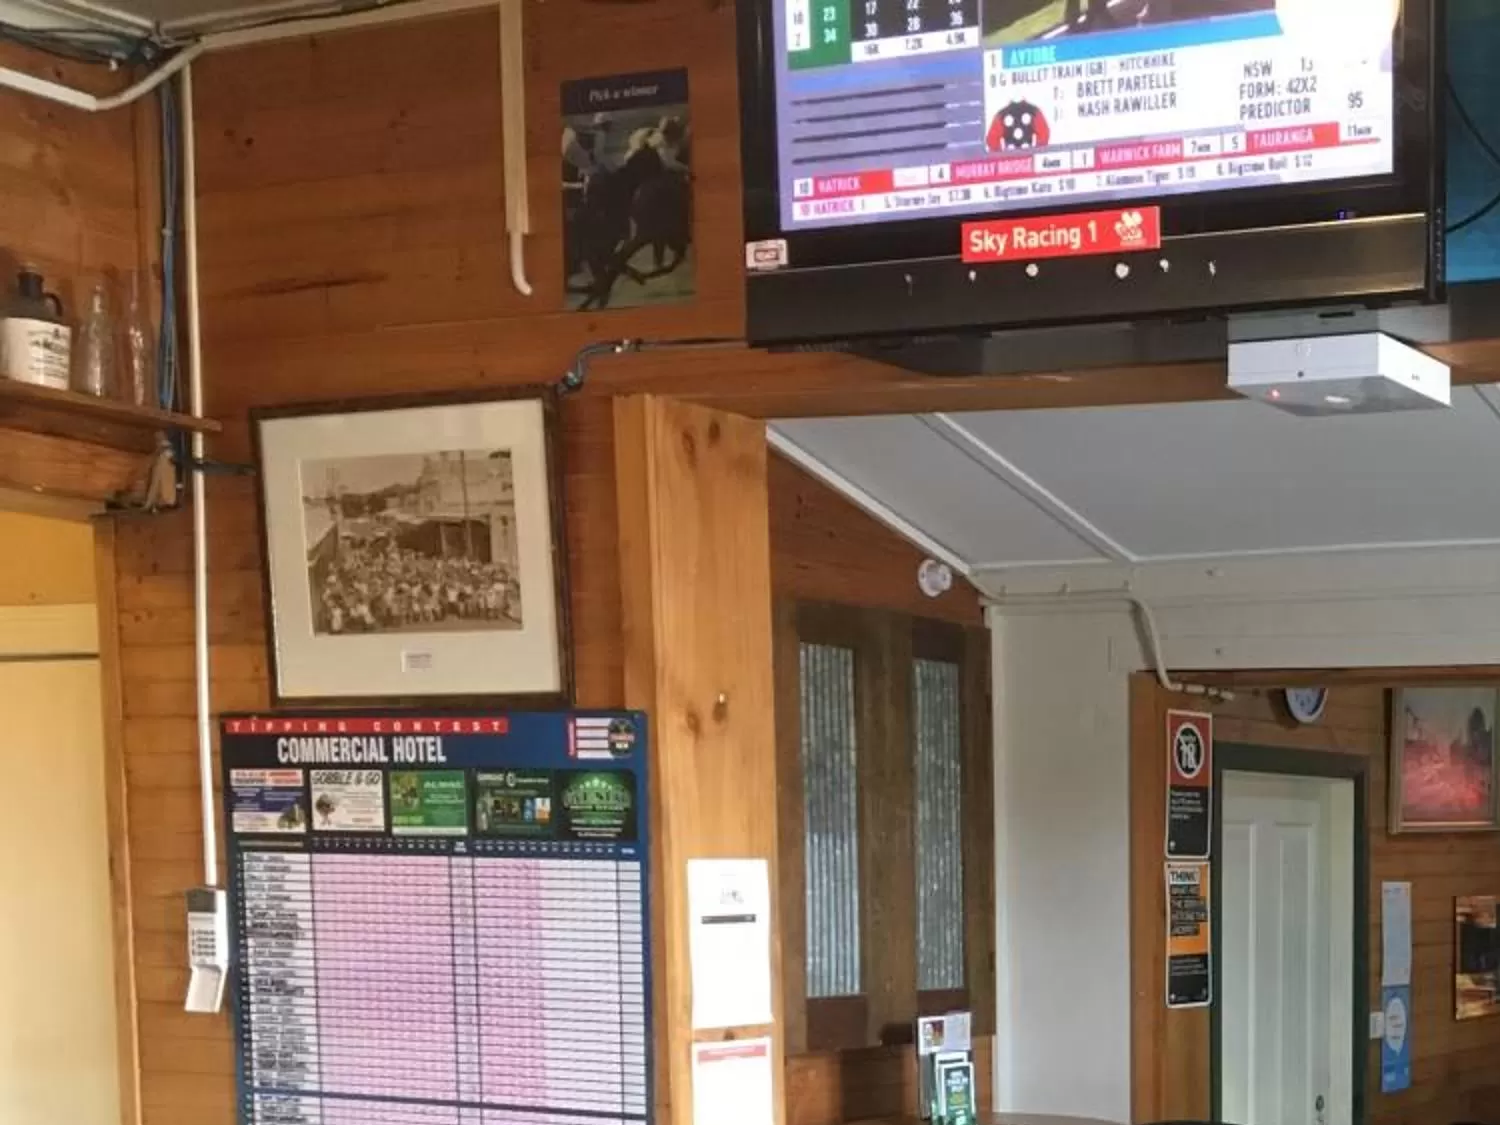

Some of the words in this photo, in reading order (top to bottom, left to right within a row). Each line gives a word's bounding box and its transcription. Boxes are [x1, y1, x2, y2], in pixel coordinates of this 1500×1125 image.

[1012, 66, 1048, 86] BULLET
[1052, 60, 1083, 81] TRAIN
[1243, 59, 1273, 78] NSW
[1076, 78, 1114, 99] BRETT
[1117, 71, 1177, 94] PARTELLE
[1077, 102, 1110, 118] NASH
[1113, 91, 1177, 113] RAWILLER
[1239, 98, 1311, 120] PREDICTOR
[1253, 127, 1315, 147] TAURANGA
[969, 229, 1009, 256] Sky
[1012, 222, 1082, 249] Racing
[1087, 219, 1098, 243] 1
[231, 720, 348, 733] TIPPING
[373, 719, 501, 733] CONTEST
[276, 736, 390, 764] COMMERCIAL
[392, 735, 448, 763] HOTEL
[365, 771, 381, 786] GO
